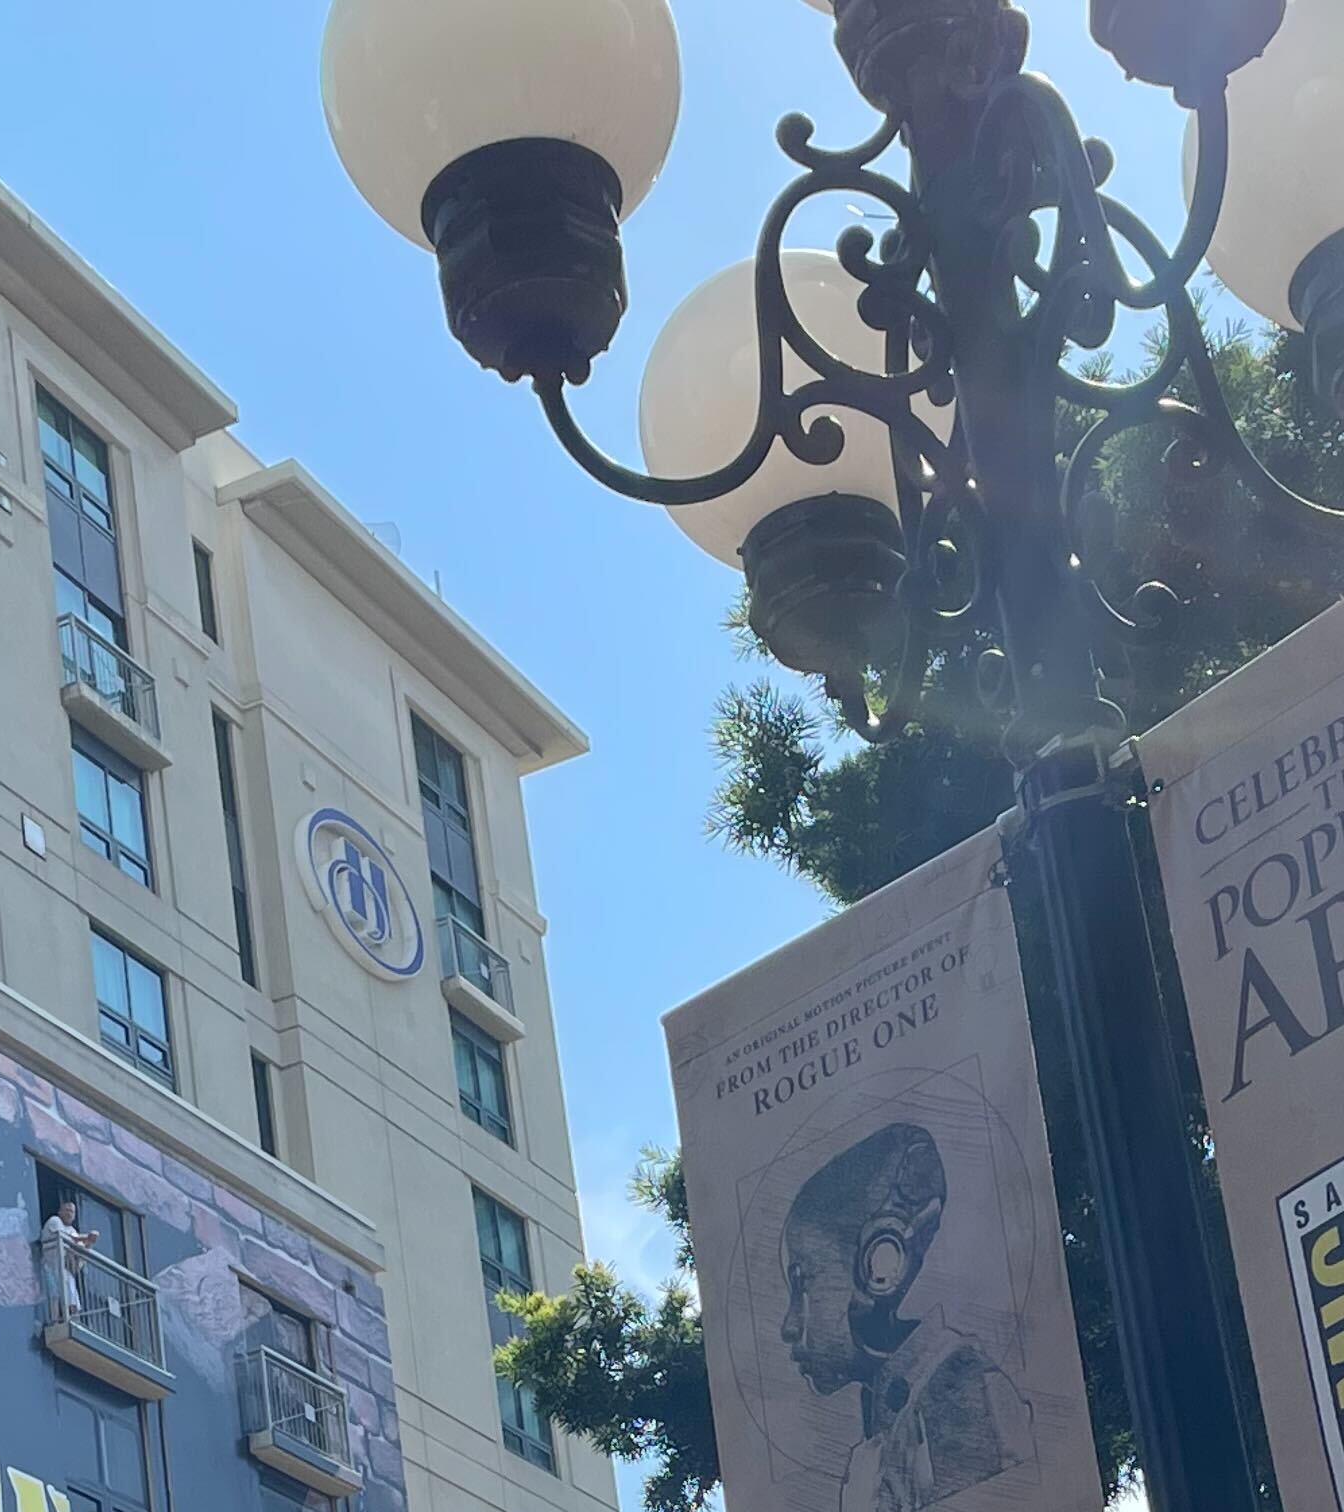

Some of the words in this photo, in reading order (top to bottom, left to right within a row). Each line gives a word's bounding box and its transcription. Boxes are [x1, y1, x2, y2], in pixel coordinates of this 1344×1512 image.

[715, 1055, 774, 1101] FROM
[778, 1029, 822, 1065] THE
[826, 966, 936, 1041] DIRECTOR
[940, 943, 973, 973] OF
[743, 1015, 802, 1054] ORIGINAL
[803, 985, 854, 1022] MOTION
[856, 956, 908, 994] PICTURE
[911, 931, 953, 962] EVENT
[752, 1037, 863, 1117] ROGUE
[872, 993, 940, 1049] ONE
